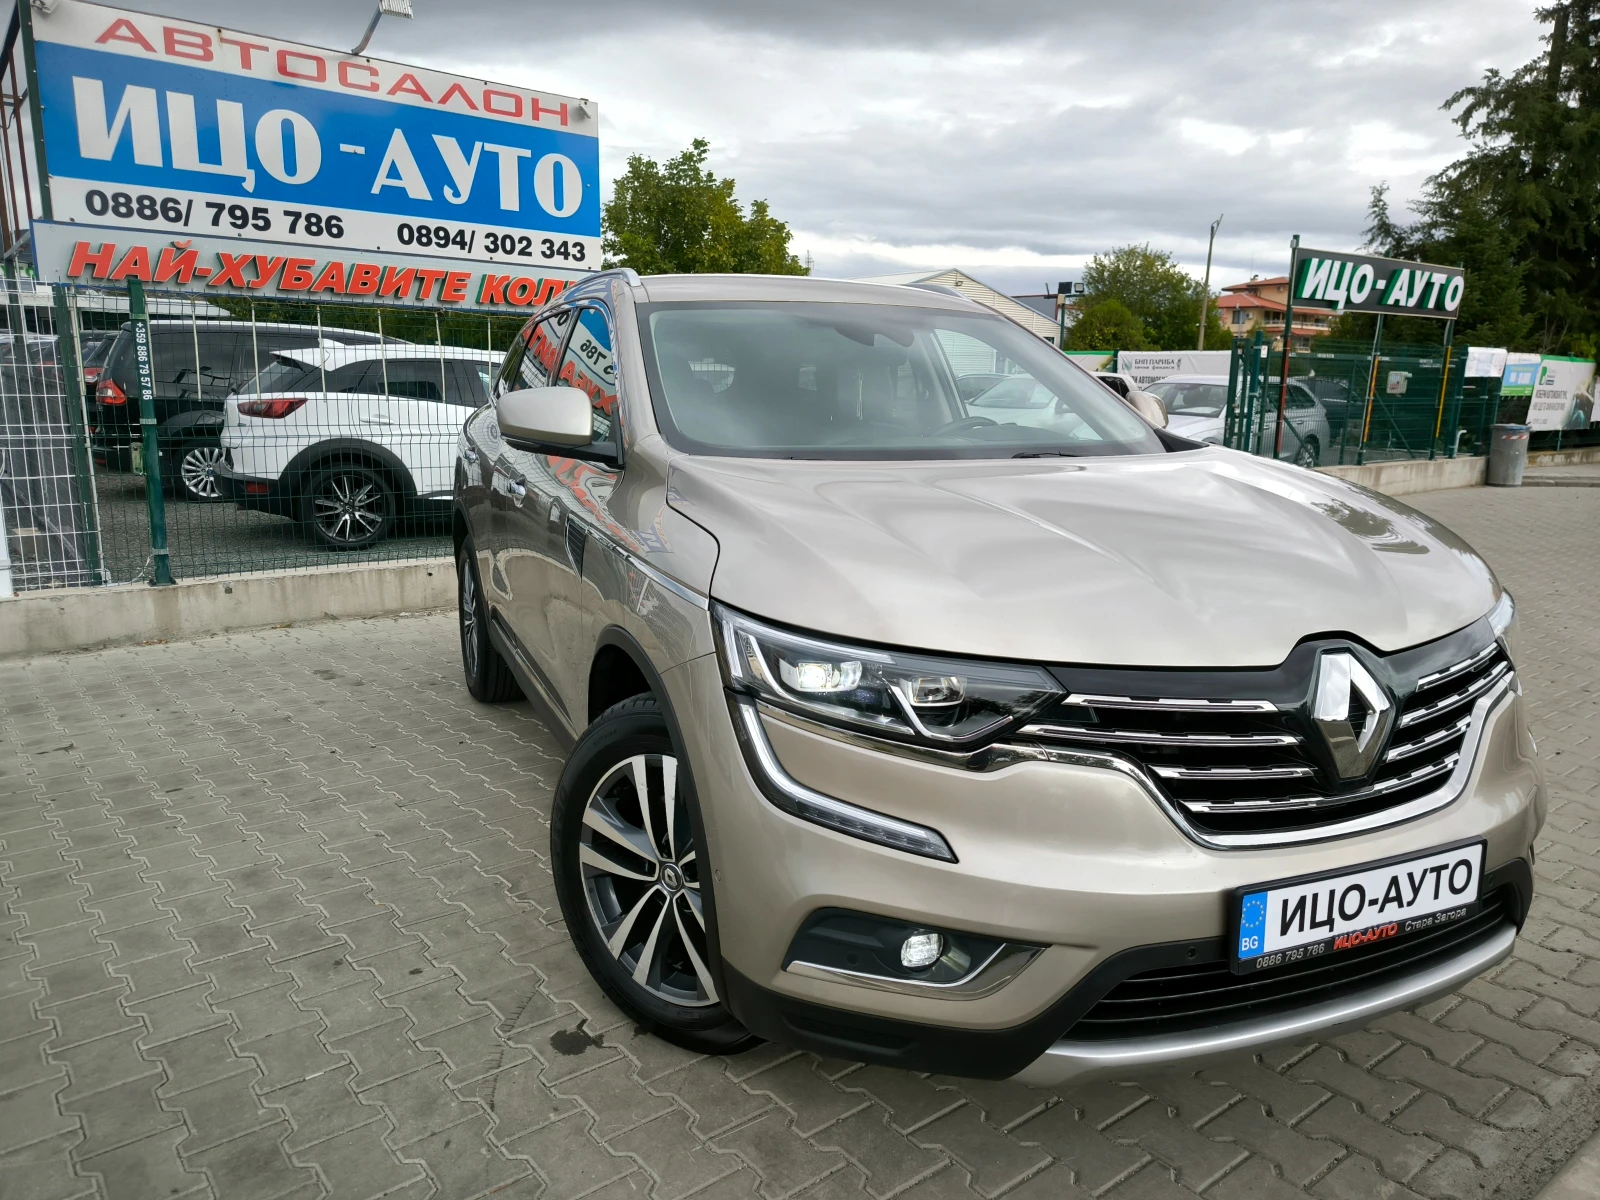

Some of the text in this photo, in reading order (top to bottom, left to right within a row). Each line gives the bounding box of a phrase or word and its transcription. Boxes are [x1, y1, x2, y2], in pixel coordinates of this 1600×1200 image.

[95, 18, 569, 127] АВТОСАЛОН
[84, 188, 586, 262] 0886/ 795 786 0894/ 302 343
[67, 239, 577, 306] НАЙ-ХУБАВИТЕ КОЛ
[1300, 257, 1465, 312] ИЦО-АУТО
[136, 322, 153, 400] +359 886 79 57 86
[1280, 858, 1473, 937] ИЦО-АУТО
[1404, 907, 1467, 932] Стара Загора
[1241, 935, 1259, 951] BG
[1256, 943, 1325, 969] 0886 795 786
[1333, 923, 1398, 950] ИЦО-АУТО
